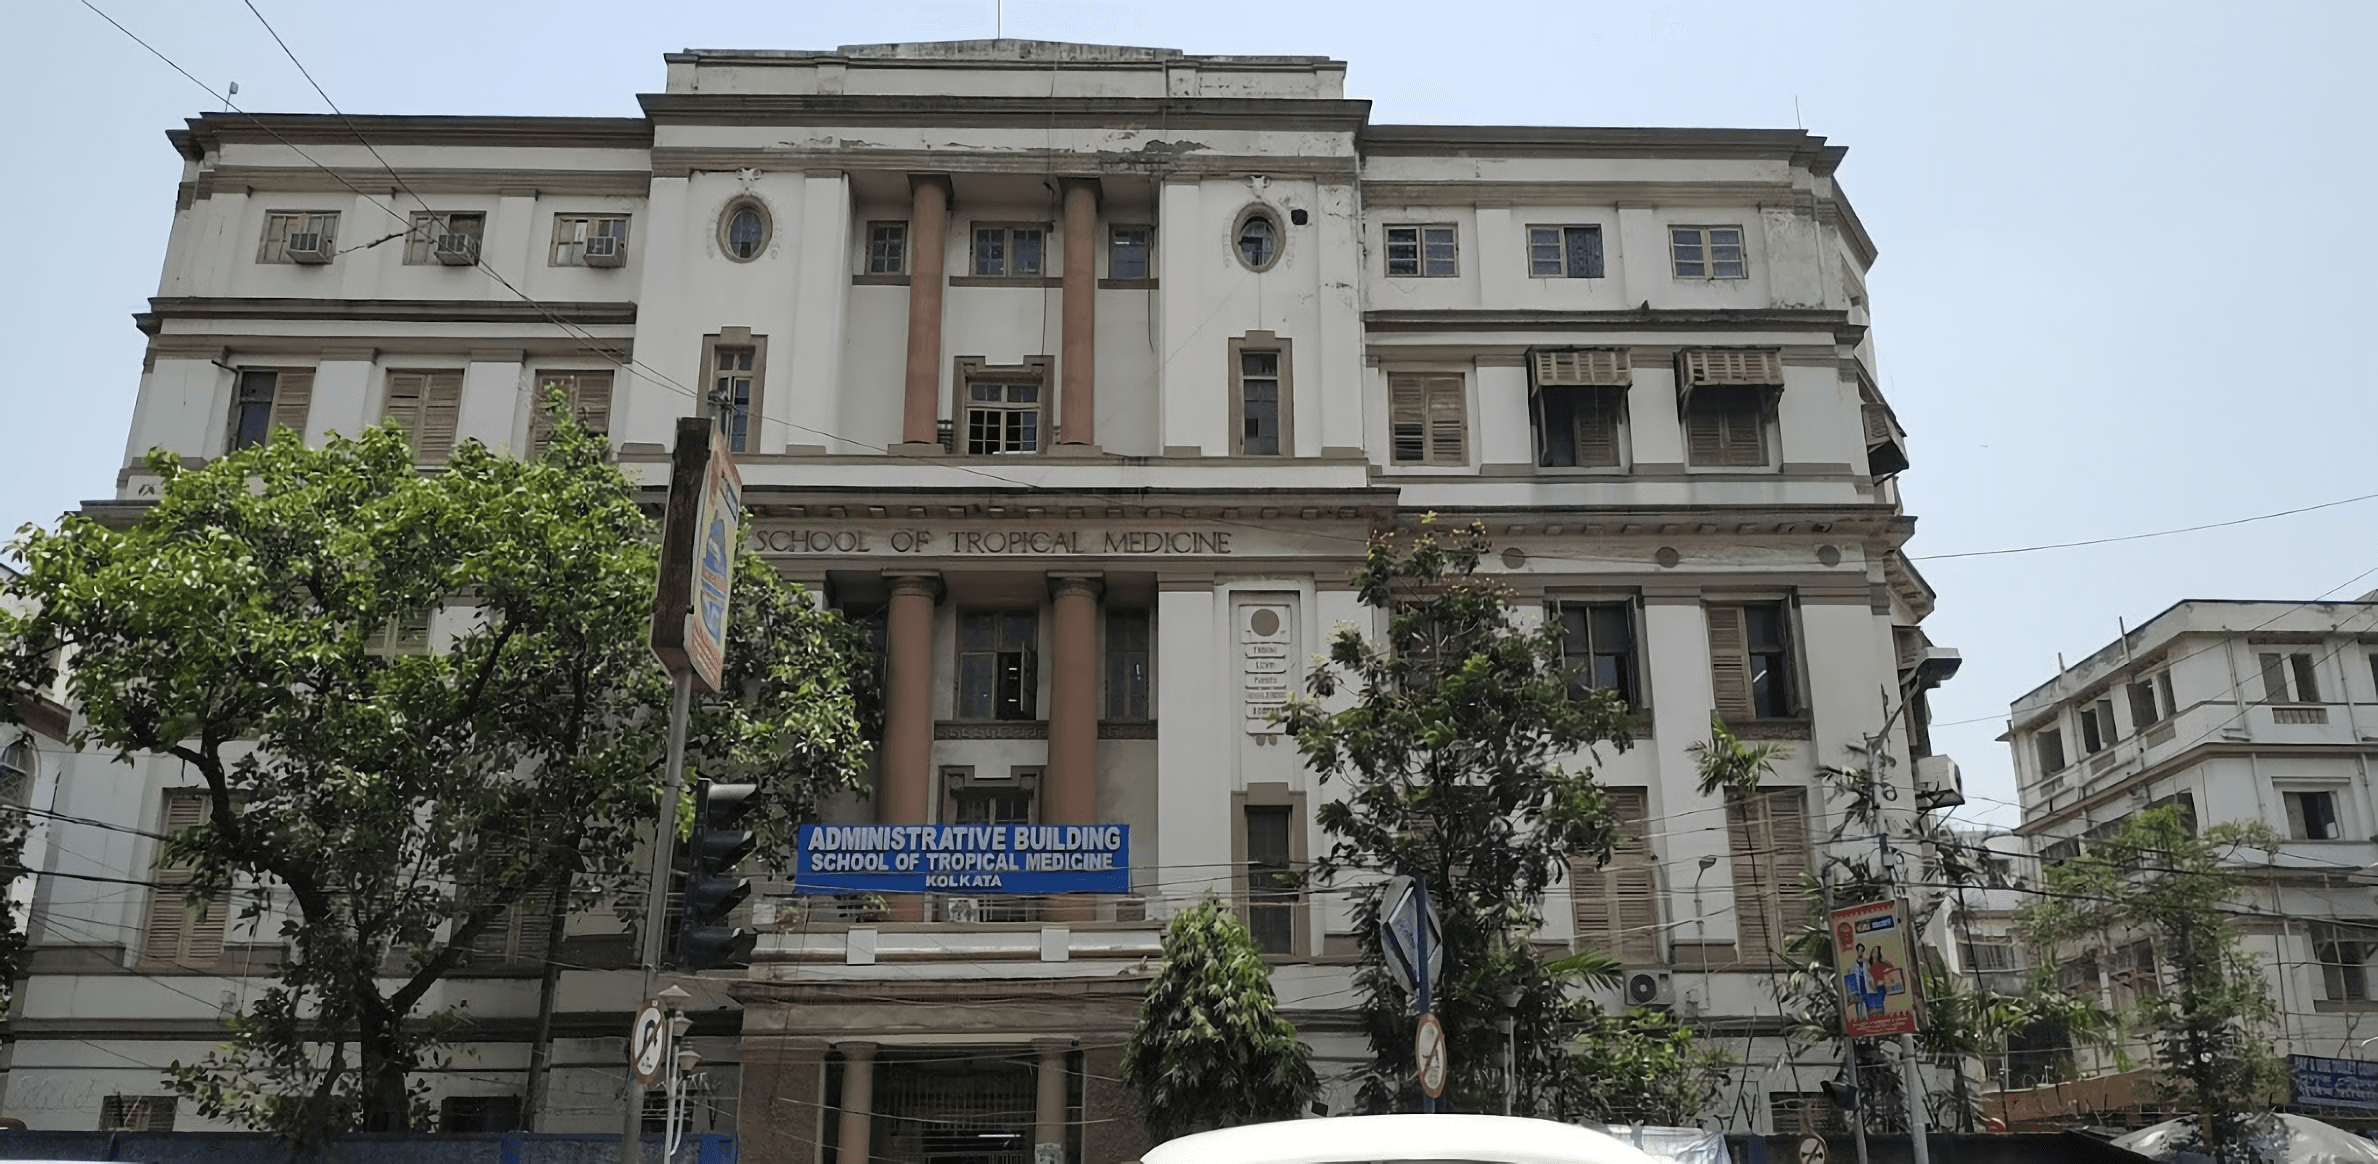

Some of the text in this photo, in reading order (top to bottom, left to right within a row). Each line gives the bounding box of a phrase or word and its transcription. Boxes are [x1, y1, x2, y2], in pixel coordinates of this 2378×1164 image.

[755, 530, 1232, 554] SCHOOL OF TROPICAL MEDICINE
[808, 826, 1121, 851] ADMINISTRATIVE BUILDING
[811, 852, 1113, 871] SCHOOL OF TROPICAL MEDICINE
[925, 875, 1002, 887] KOLKATA
